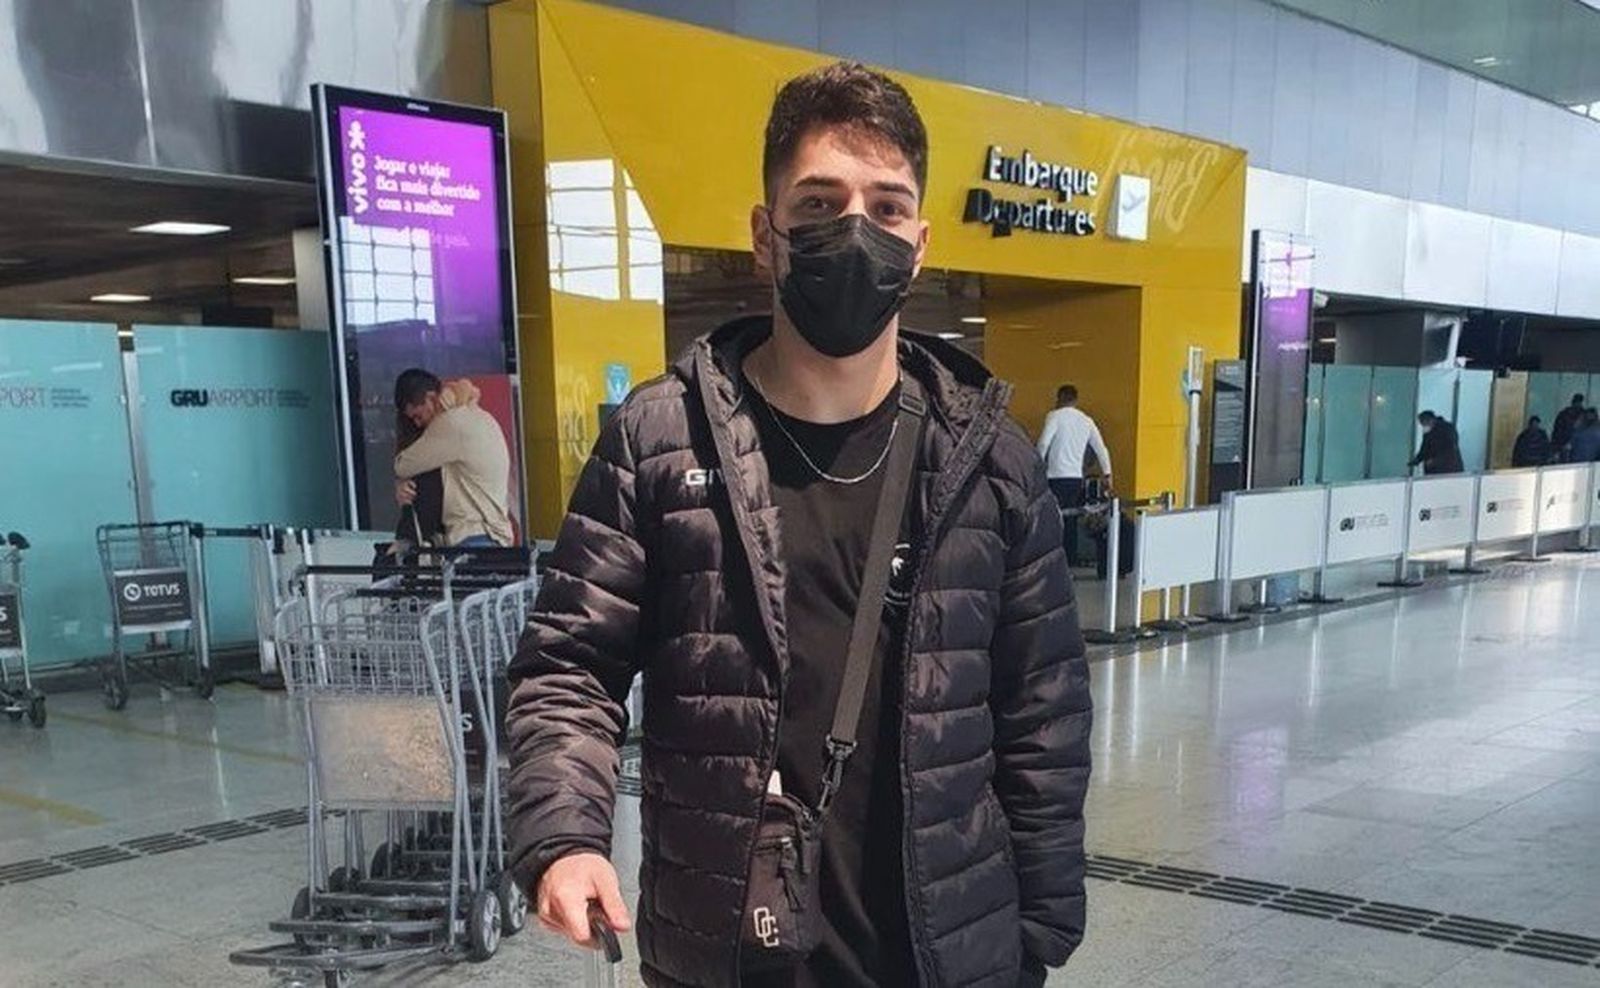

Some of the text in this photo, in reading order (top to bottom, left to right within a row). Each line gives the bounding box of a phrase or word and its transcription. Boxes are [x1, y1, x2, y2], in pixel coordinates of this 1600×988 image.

[348, 152, 368, 213] vivo
[430, 181, 480, 201] divertido
[986, 146, 1098, 202] Embarque
[966, 189, 1096, 237] Departures
